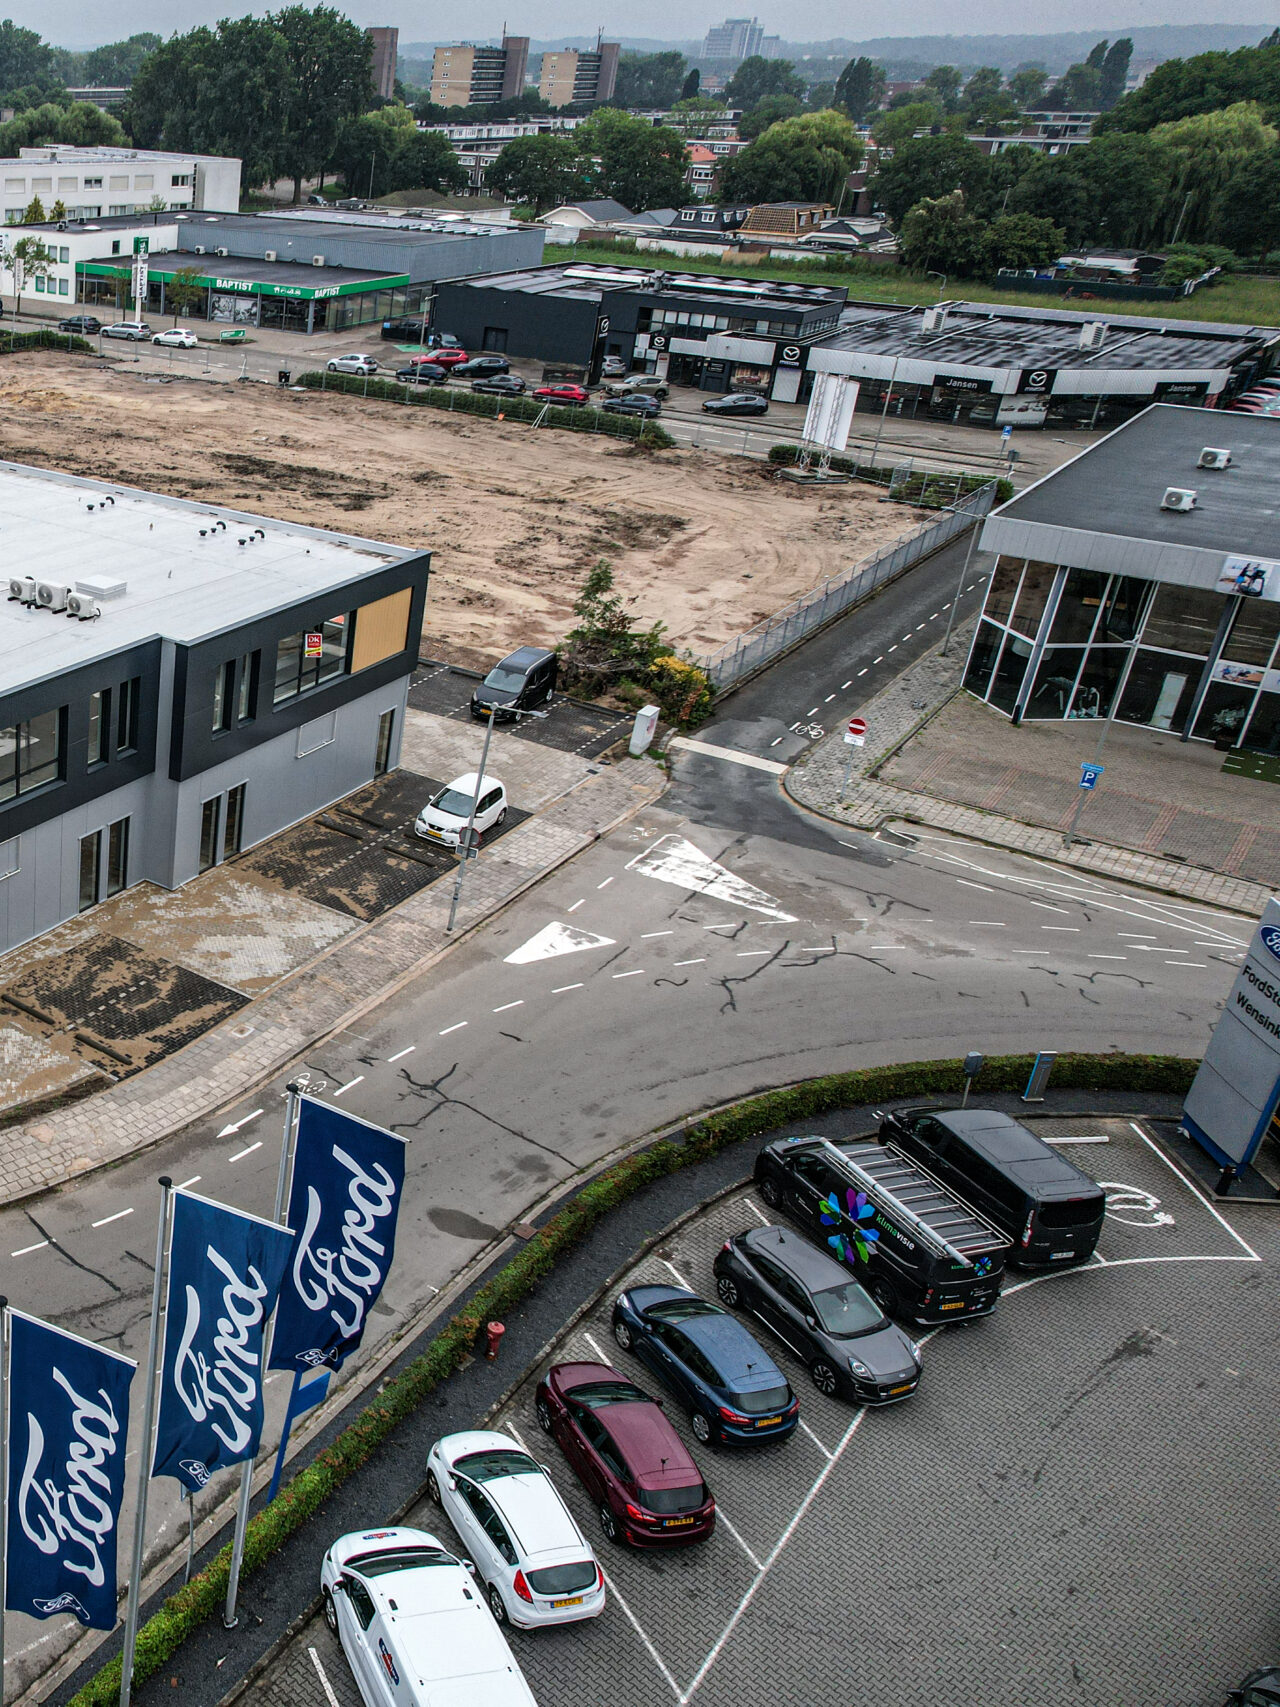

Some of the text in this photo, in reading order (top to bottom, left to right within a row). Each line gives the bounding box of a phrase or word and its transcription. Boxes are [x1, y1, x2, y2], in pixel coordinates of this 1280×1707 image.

[216, 279, 254, 292] BAPTIST
[314, 286, 340, 299] BAPTIST
[946, 379, 978, 389] Jansen
[1167, 384, 1197, 392] Jansen
[308, 635, 320, 643] DK
[1084, 771, 1095, 781] P
[1236, 991, 1280, 1041] Wensink
[875, 1213, 916, 1251] klimavisie
[293, 1143, 396, 1339] Ford
[174, 1244, 268, 1453] Ford
[19, 1366, 119, 1587] Ford
